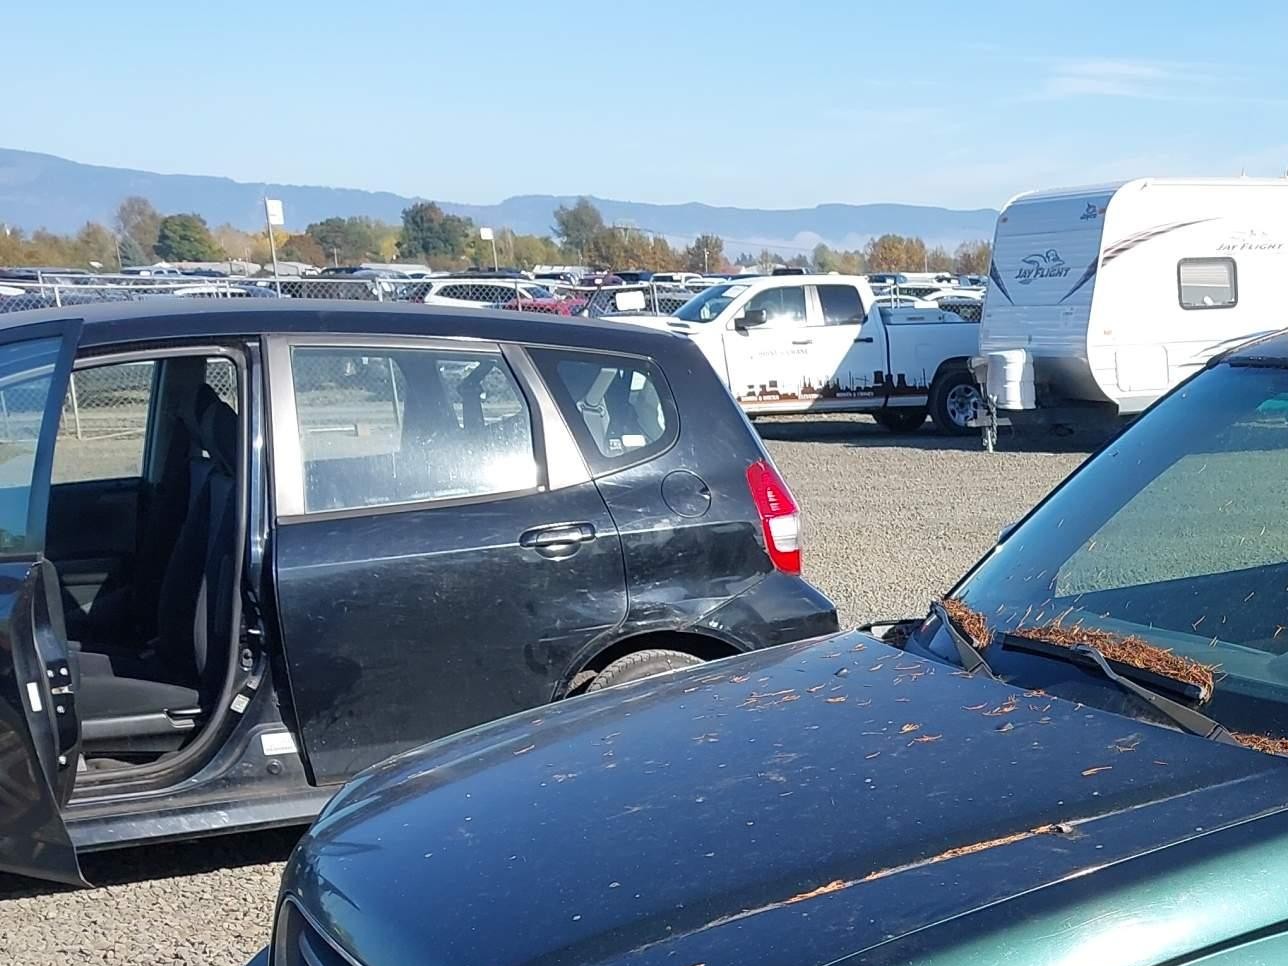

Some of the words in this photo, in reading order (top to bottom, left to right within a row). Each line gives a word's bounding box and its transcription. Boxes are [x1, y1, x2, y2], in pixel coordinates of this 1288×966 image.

[1240, 242, 1284, 250] FLIGHT
[1014, 268, 1034, 279] JAY
[1033, 266, 1071, 278] FLIGHT
